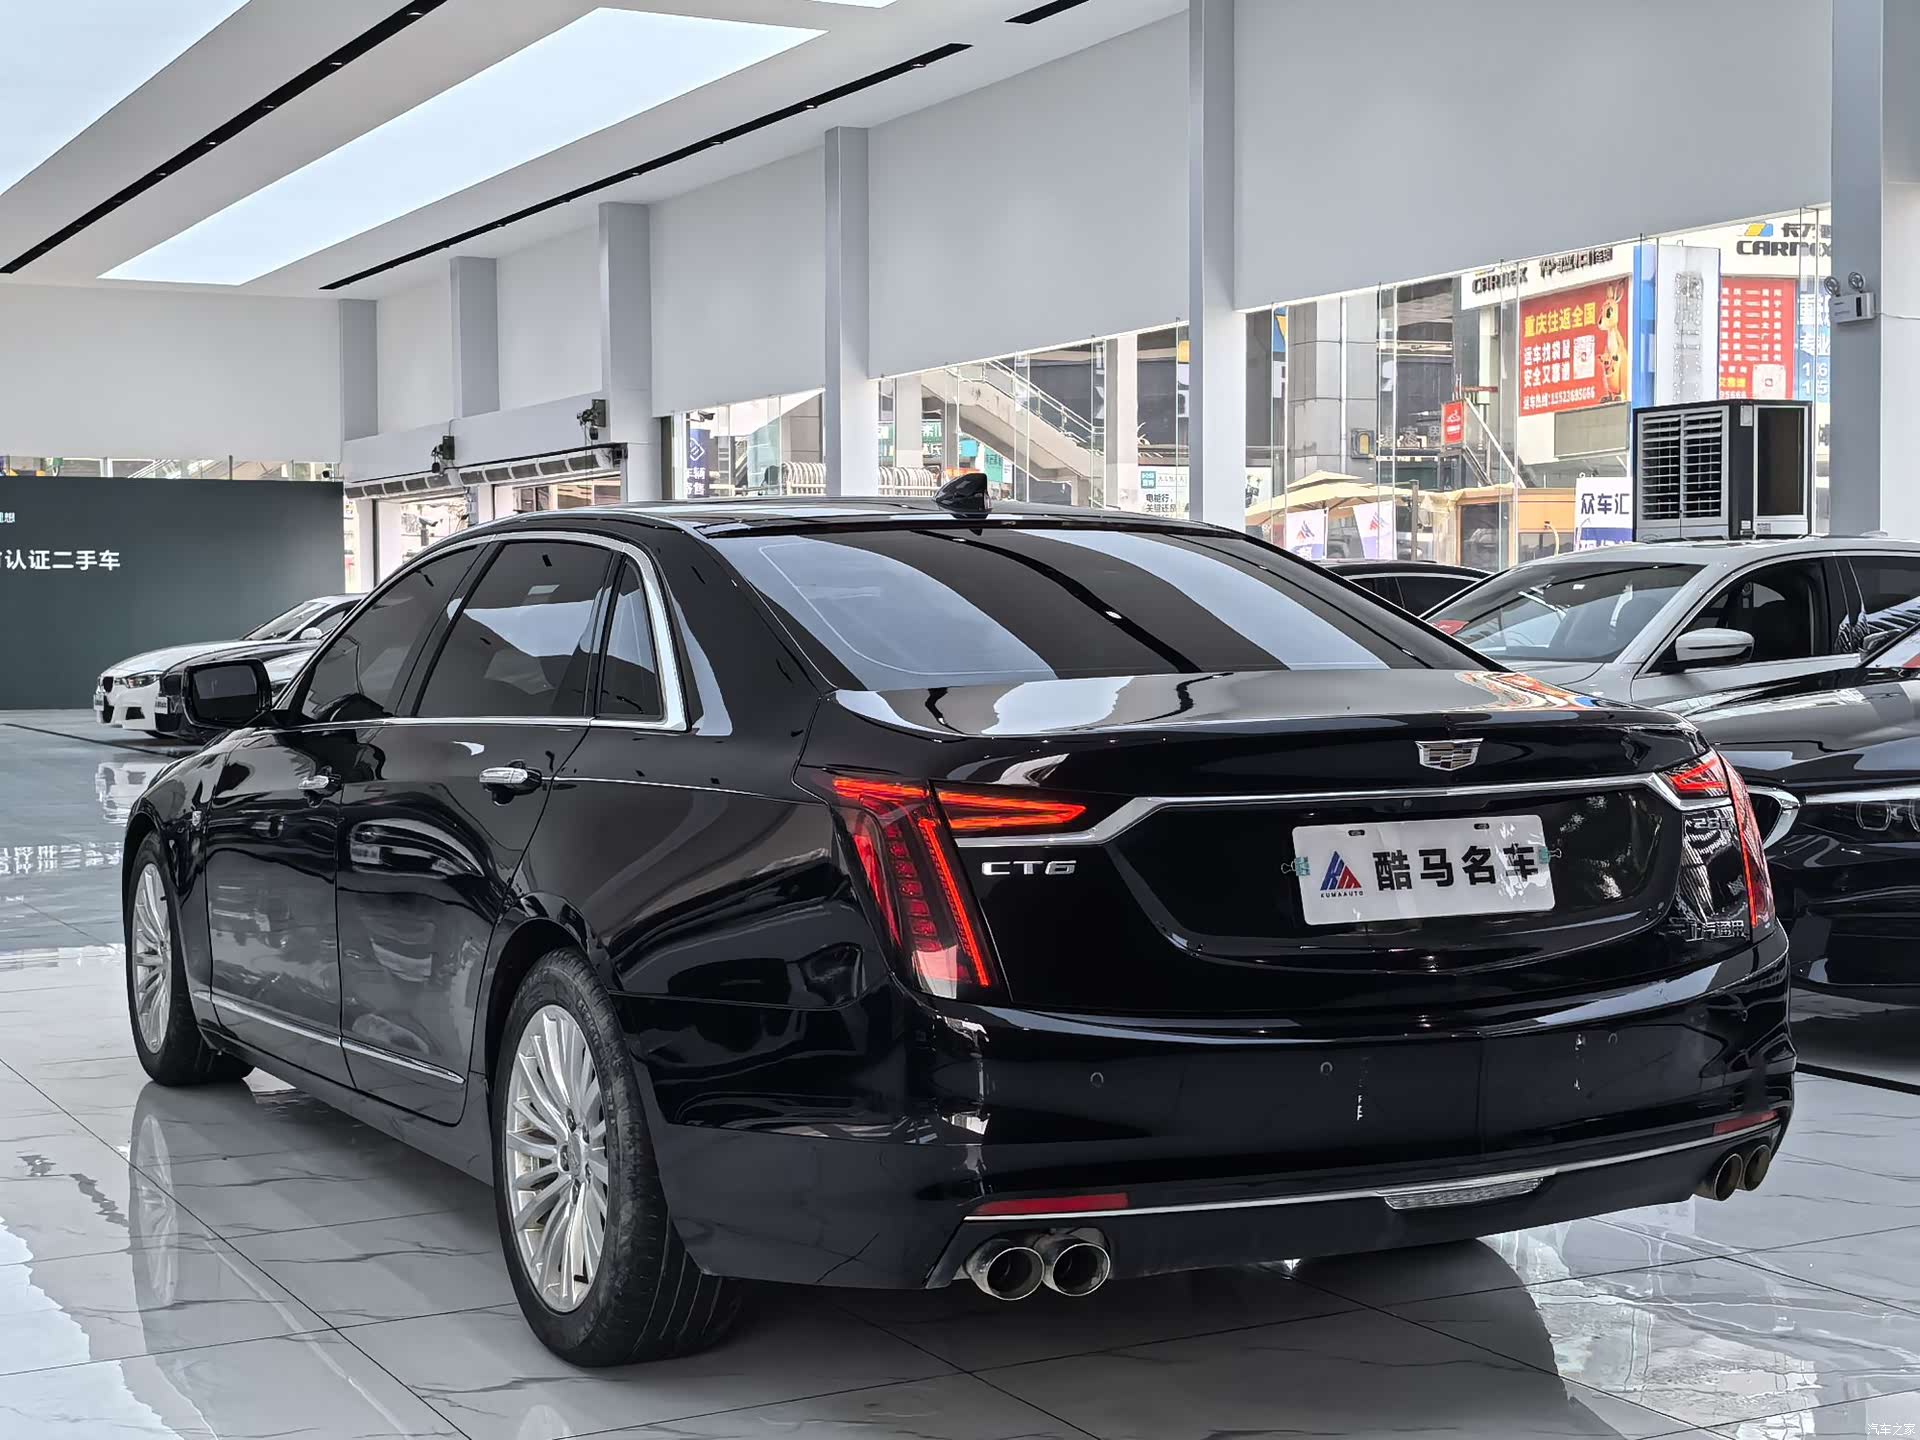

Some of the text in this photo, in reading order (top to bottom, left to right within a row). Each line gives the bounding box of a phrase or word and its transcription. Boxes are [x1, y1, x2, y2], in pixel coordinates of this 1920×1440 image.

[1524, 302, 1596, 338] 重庆往返全国
[1581, 493, 1630, 515] 众车汇
[0, 549, 121, 571] 认证二手车
[981, 860, 1078, 876] CT6
[1372, 844, 1540, 892] 酷马名车
[1320, 890, 1364, 899] KUMAAUTO
